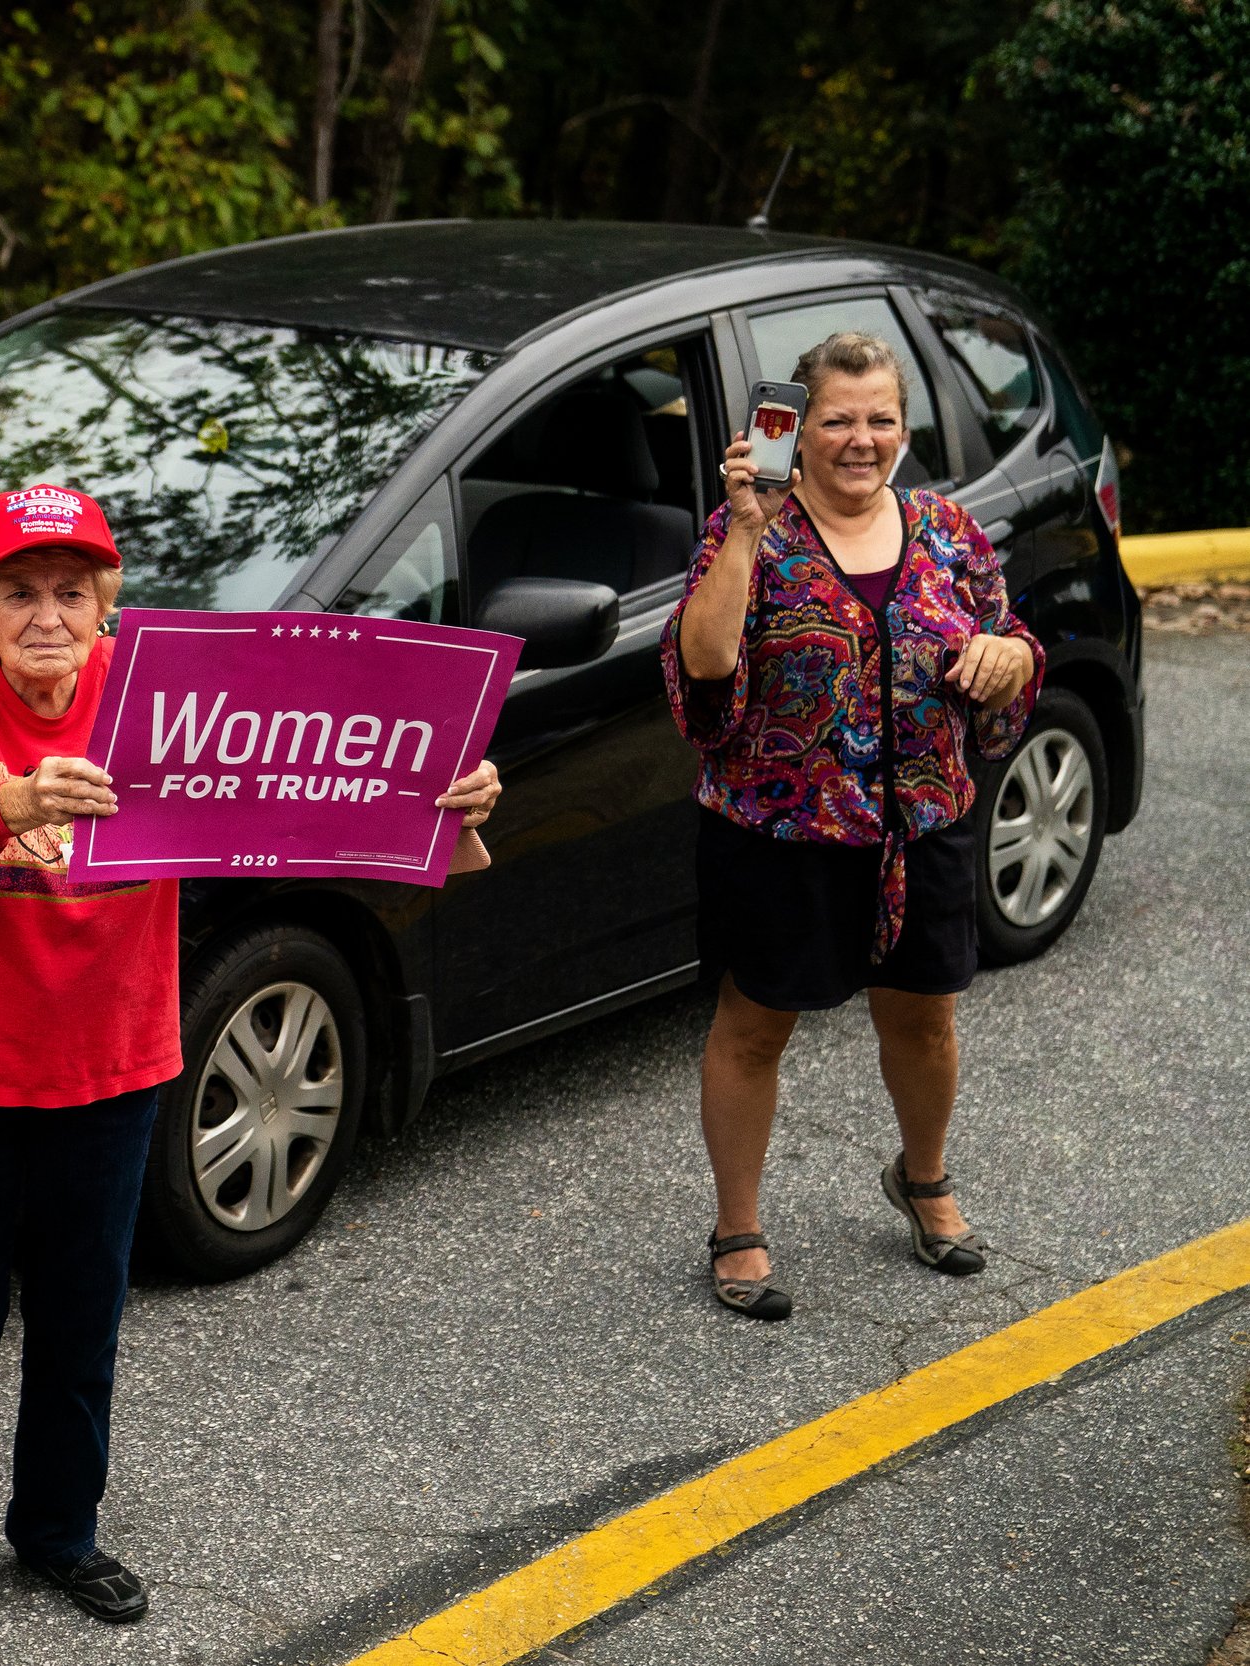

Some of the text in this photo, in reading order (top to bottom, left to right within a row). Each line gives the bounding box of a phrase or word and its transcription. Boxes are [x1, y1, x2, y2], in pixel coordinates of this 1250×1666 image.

[24, 505, 74, 517] 2020
[20, 520, 53, 528] Promises
[22, 526, 55, 534] Promises
[150, 691, 433, 772] Women
[159, 774, 389, 803] FOR TRUMP
[231, 855, 278, 867] 2020
